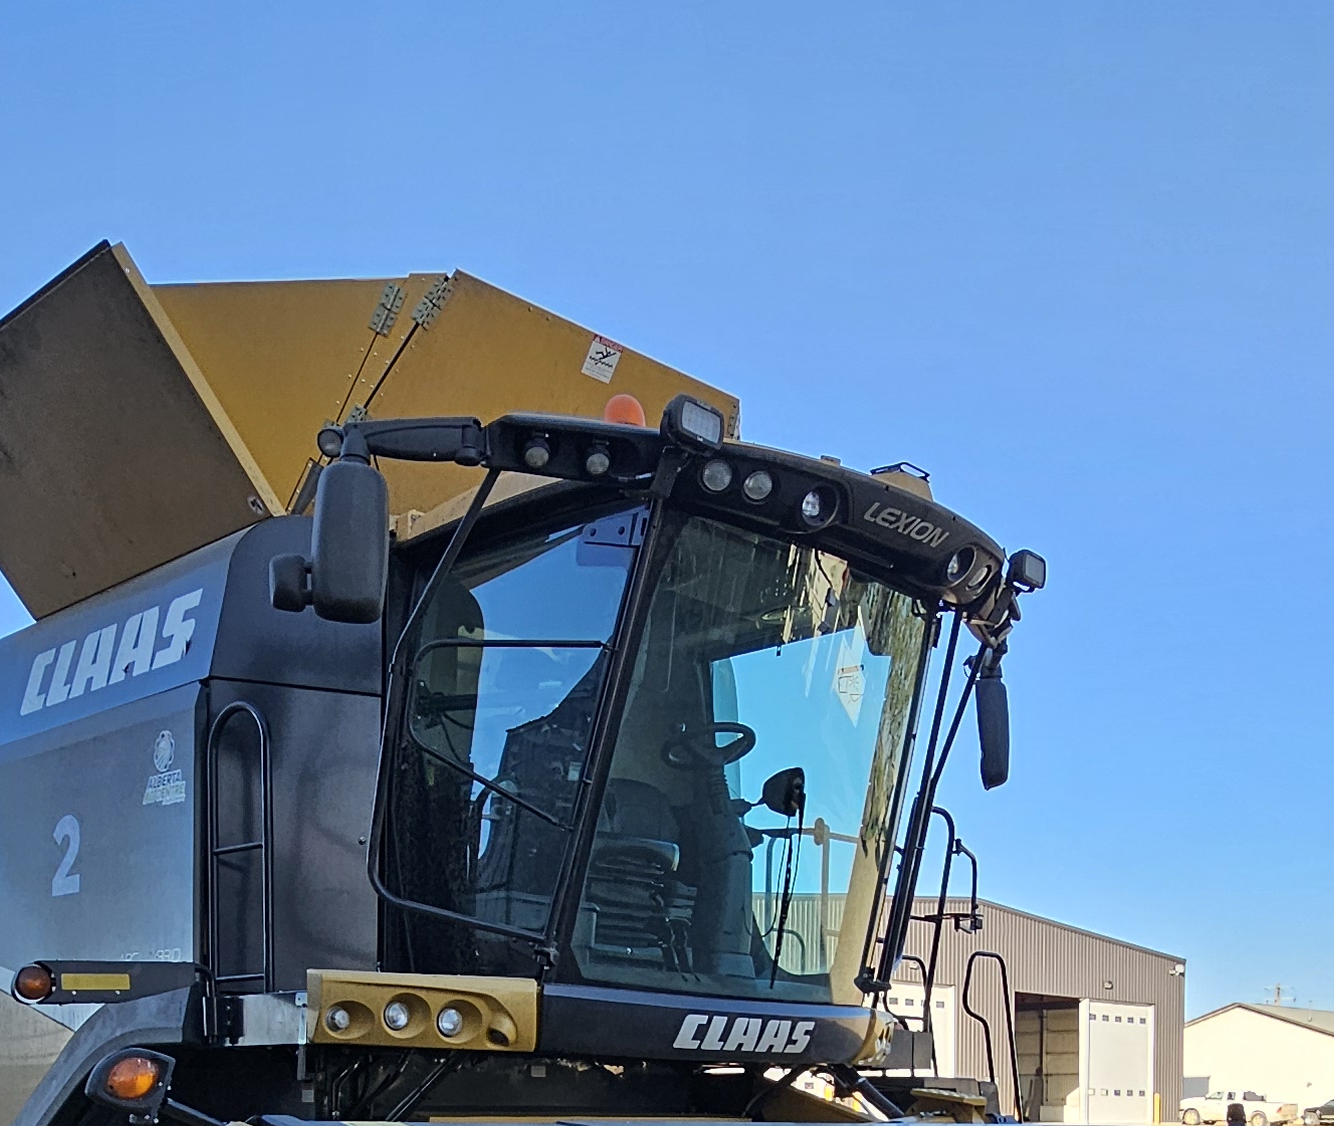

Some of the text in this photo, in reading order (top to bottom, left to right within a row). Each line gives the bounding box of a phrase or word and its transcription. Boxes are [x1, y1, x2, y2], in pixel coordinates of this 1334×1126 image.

[863, 501, 950, 549] LEXION
[20, 587, 204, 717] CLAAS
[51, 813, 81, 897] 2
[672, 1013, 816, 1054] CLAAS
